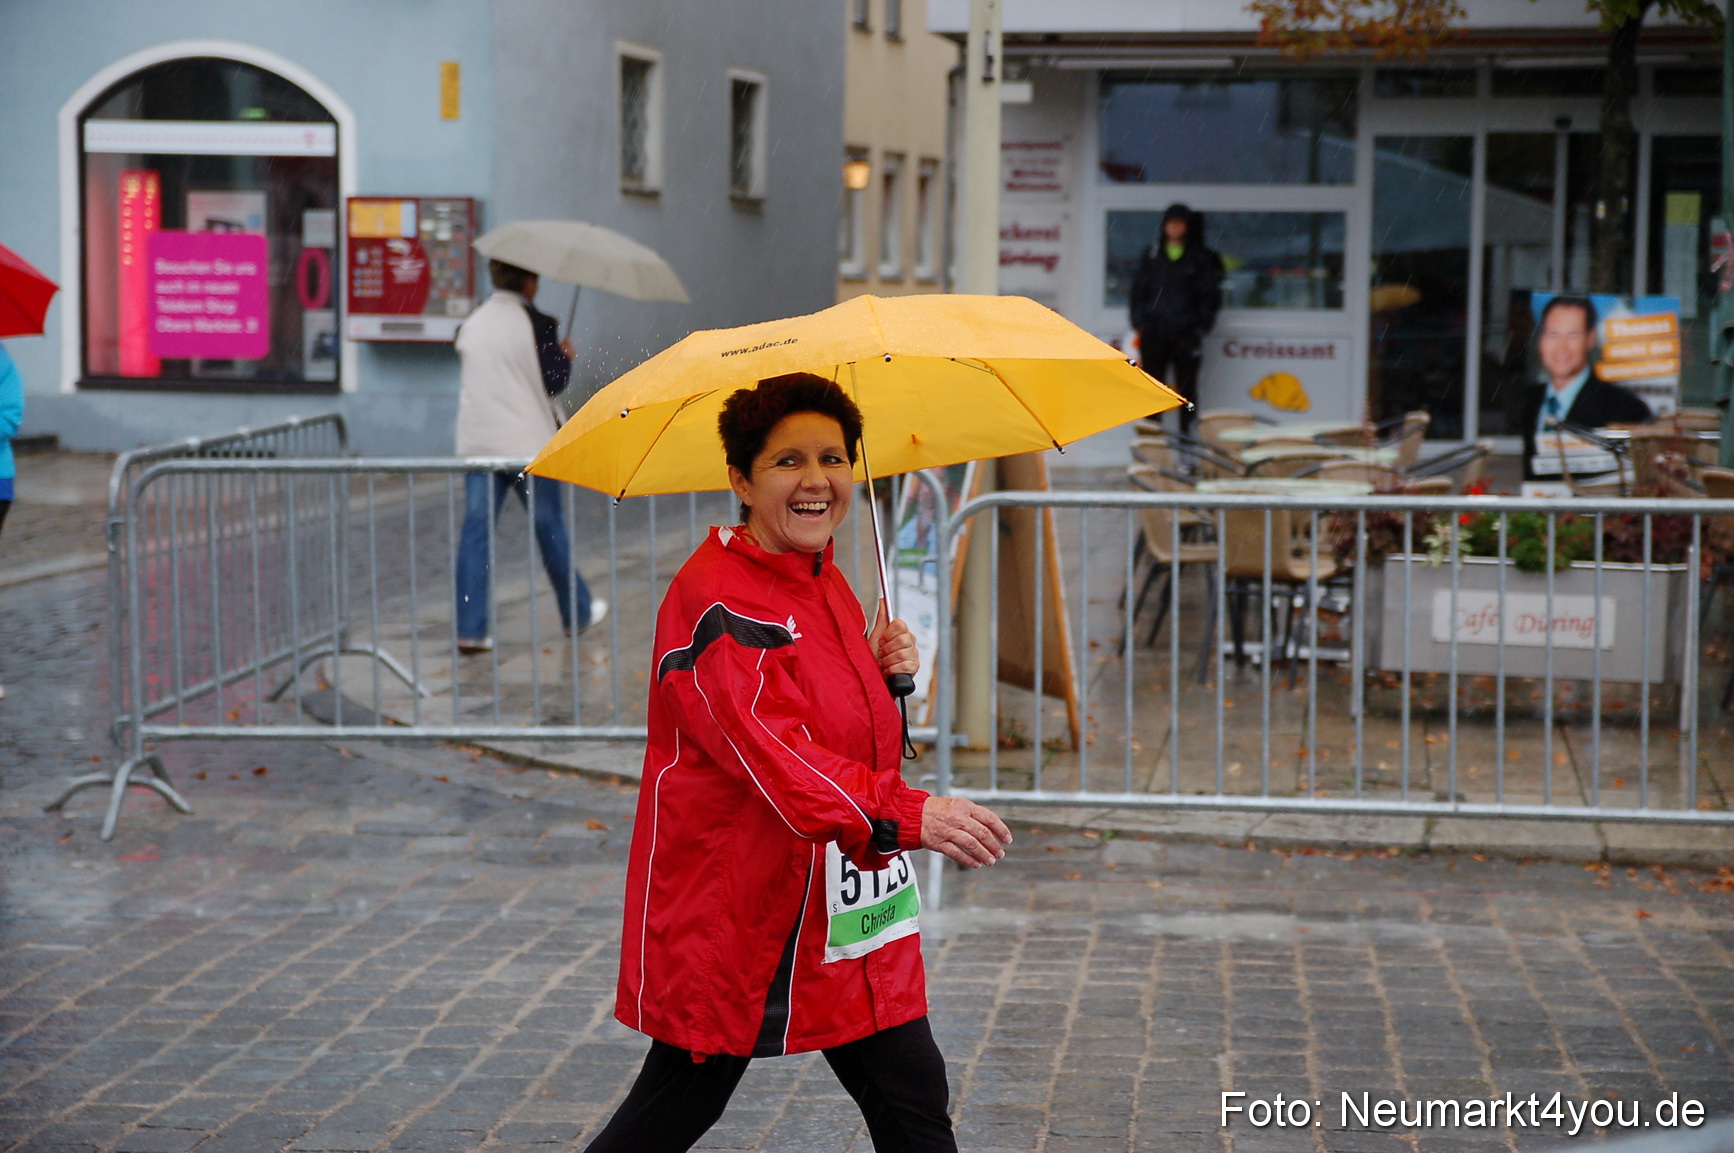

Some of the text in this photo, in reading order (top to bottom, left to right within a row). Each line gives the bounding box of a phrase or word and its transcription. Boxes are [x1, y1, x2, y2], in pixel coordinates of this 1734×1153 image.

[999, 222, 1060, 241] ckerei
[721, 338, 798, 357] www.adac.de
[1223, 340, 1336, 359] Croissant
[861, 904, 896, 935] Christa
